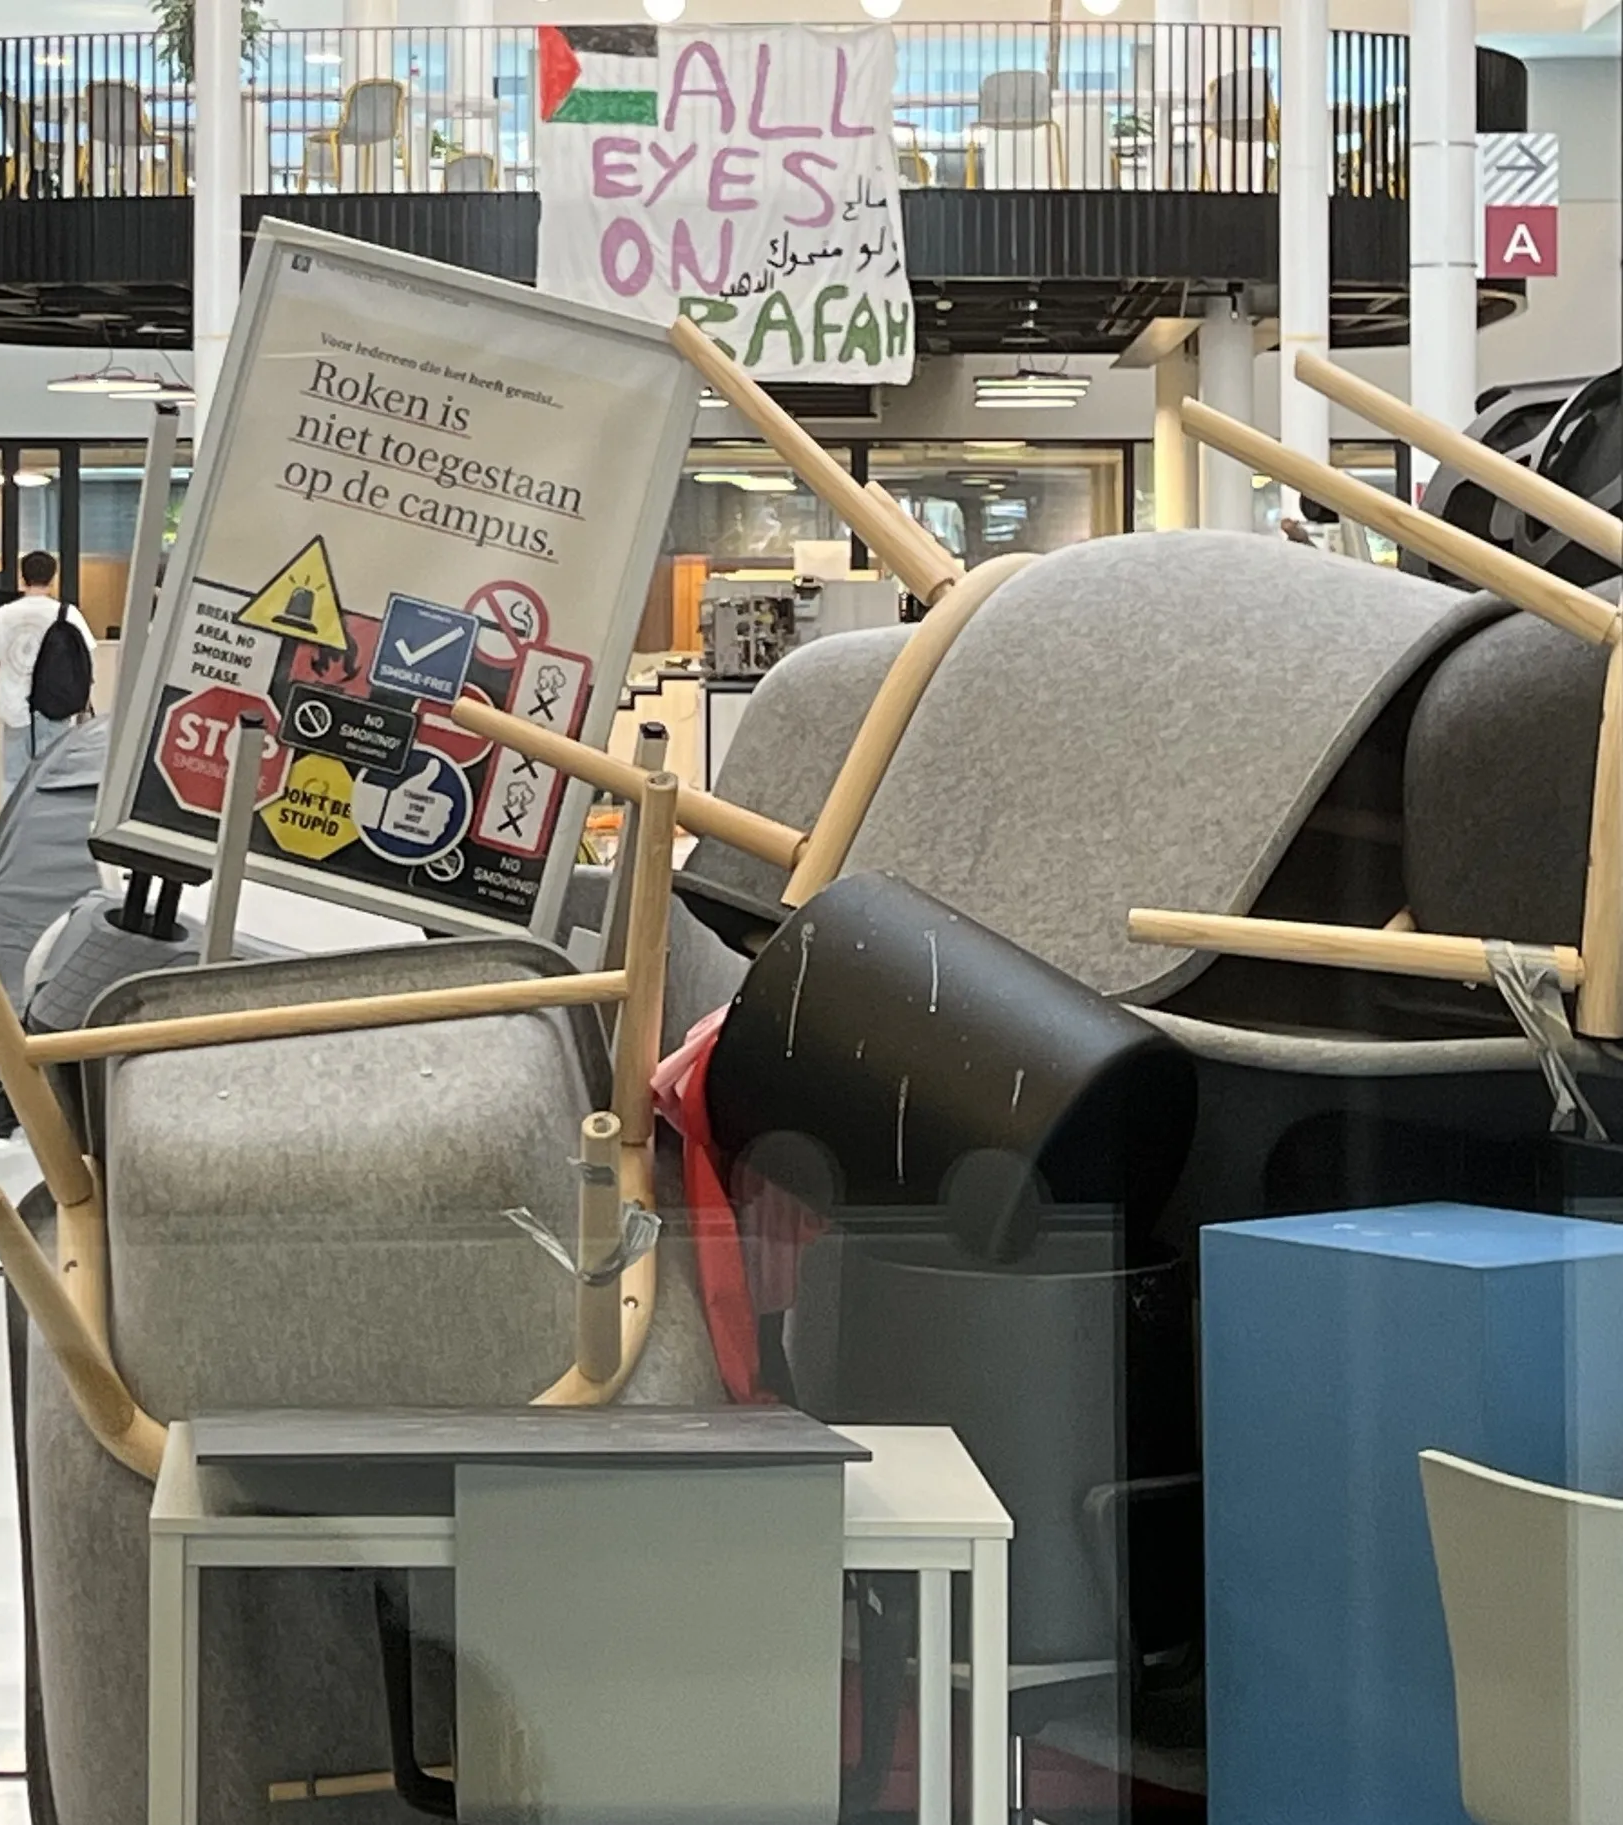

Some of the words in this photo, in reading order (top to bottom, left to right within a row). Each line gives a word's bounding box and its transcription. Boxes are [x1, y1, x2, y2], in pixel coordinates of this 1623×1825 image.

[664, 40, 875, 141] ALL
[591, 135, 838, 229] EYES
[600, 215, 734, 298] ON
[1502, 222, 1542, 264] A
[678, 284, 908, 367] RAFAH
[320, 331, 353, 351] Voor
[355, 341, 418, 370] iedereen
[419, 360, 442, 376] die
[443, 366, 467, 383] het
[469, 372, 505, 394] heeft
[308, 359, 429, 421] Roken
[439, 395, 471, 432] is
[294, 413, 374, 456] niet
[380, 432, 583, 514] toegestaan
[283, 460, 333, 502] op
[342, 469, 391, 509] de
[398, 491, 556, 557] campus.
[192, 641, 253, 669] SMOKING
[195, 622, 233, 645] AREA.
[236, 633, 257, 650] NO
[191, 661, 242, 687] PLEASE.
[379, 663, 454, 693] SMOKE-FREE
[363, 713, 385, 729] NO
[278, 807, 340, 837] STUPID
[329, 798, 352, 819] BE
[499, 855, 521, 873] NO
